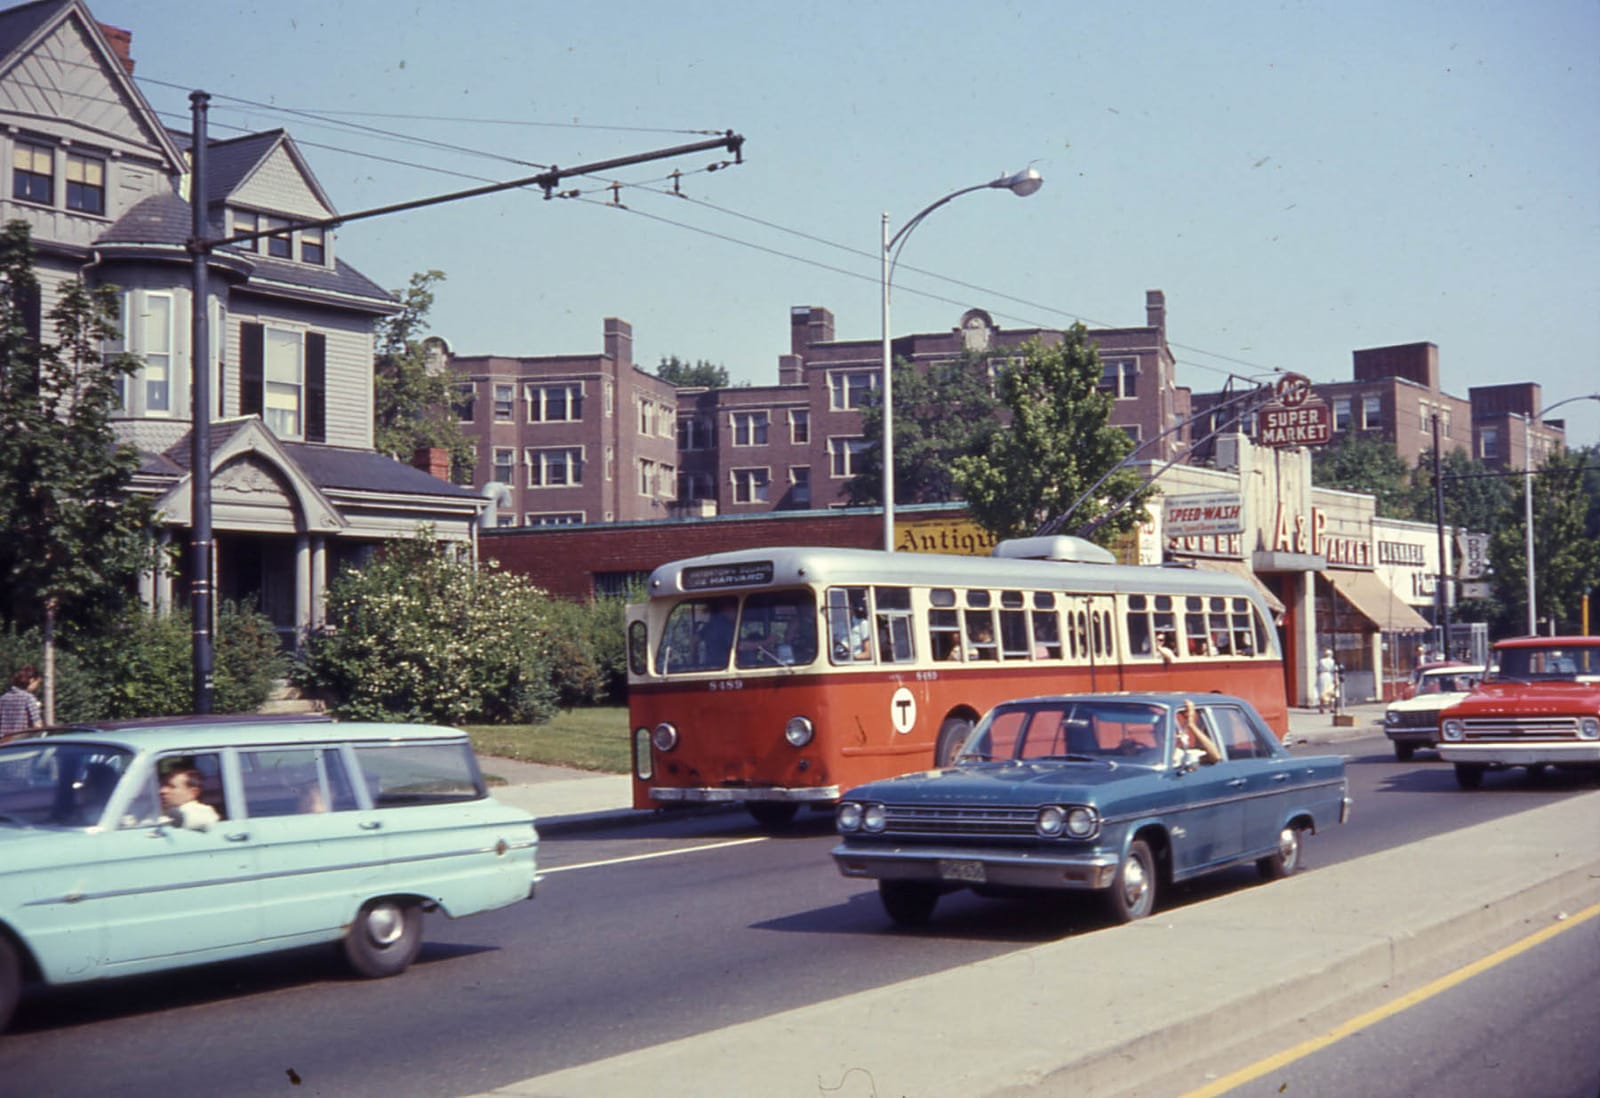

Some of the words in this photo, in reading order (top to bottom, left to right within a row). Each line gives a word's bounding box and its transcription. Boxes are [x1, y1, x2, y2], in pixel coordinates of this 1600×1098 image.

[1267, 410, 1319, 427] SUPER
[1263, 425, 1327, 443] MARKET
[1168, 506, 1241, 522] SPEED-WASH
[897, 529, 999, 553] Antiqu
[897, 701, 911, 725] T
